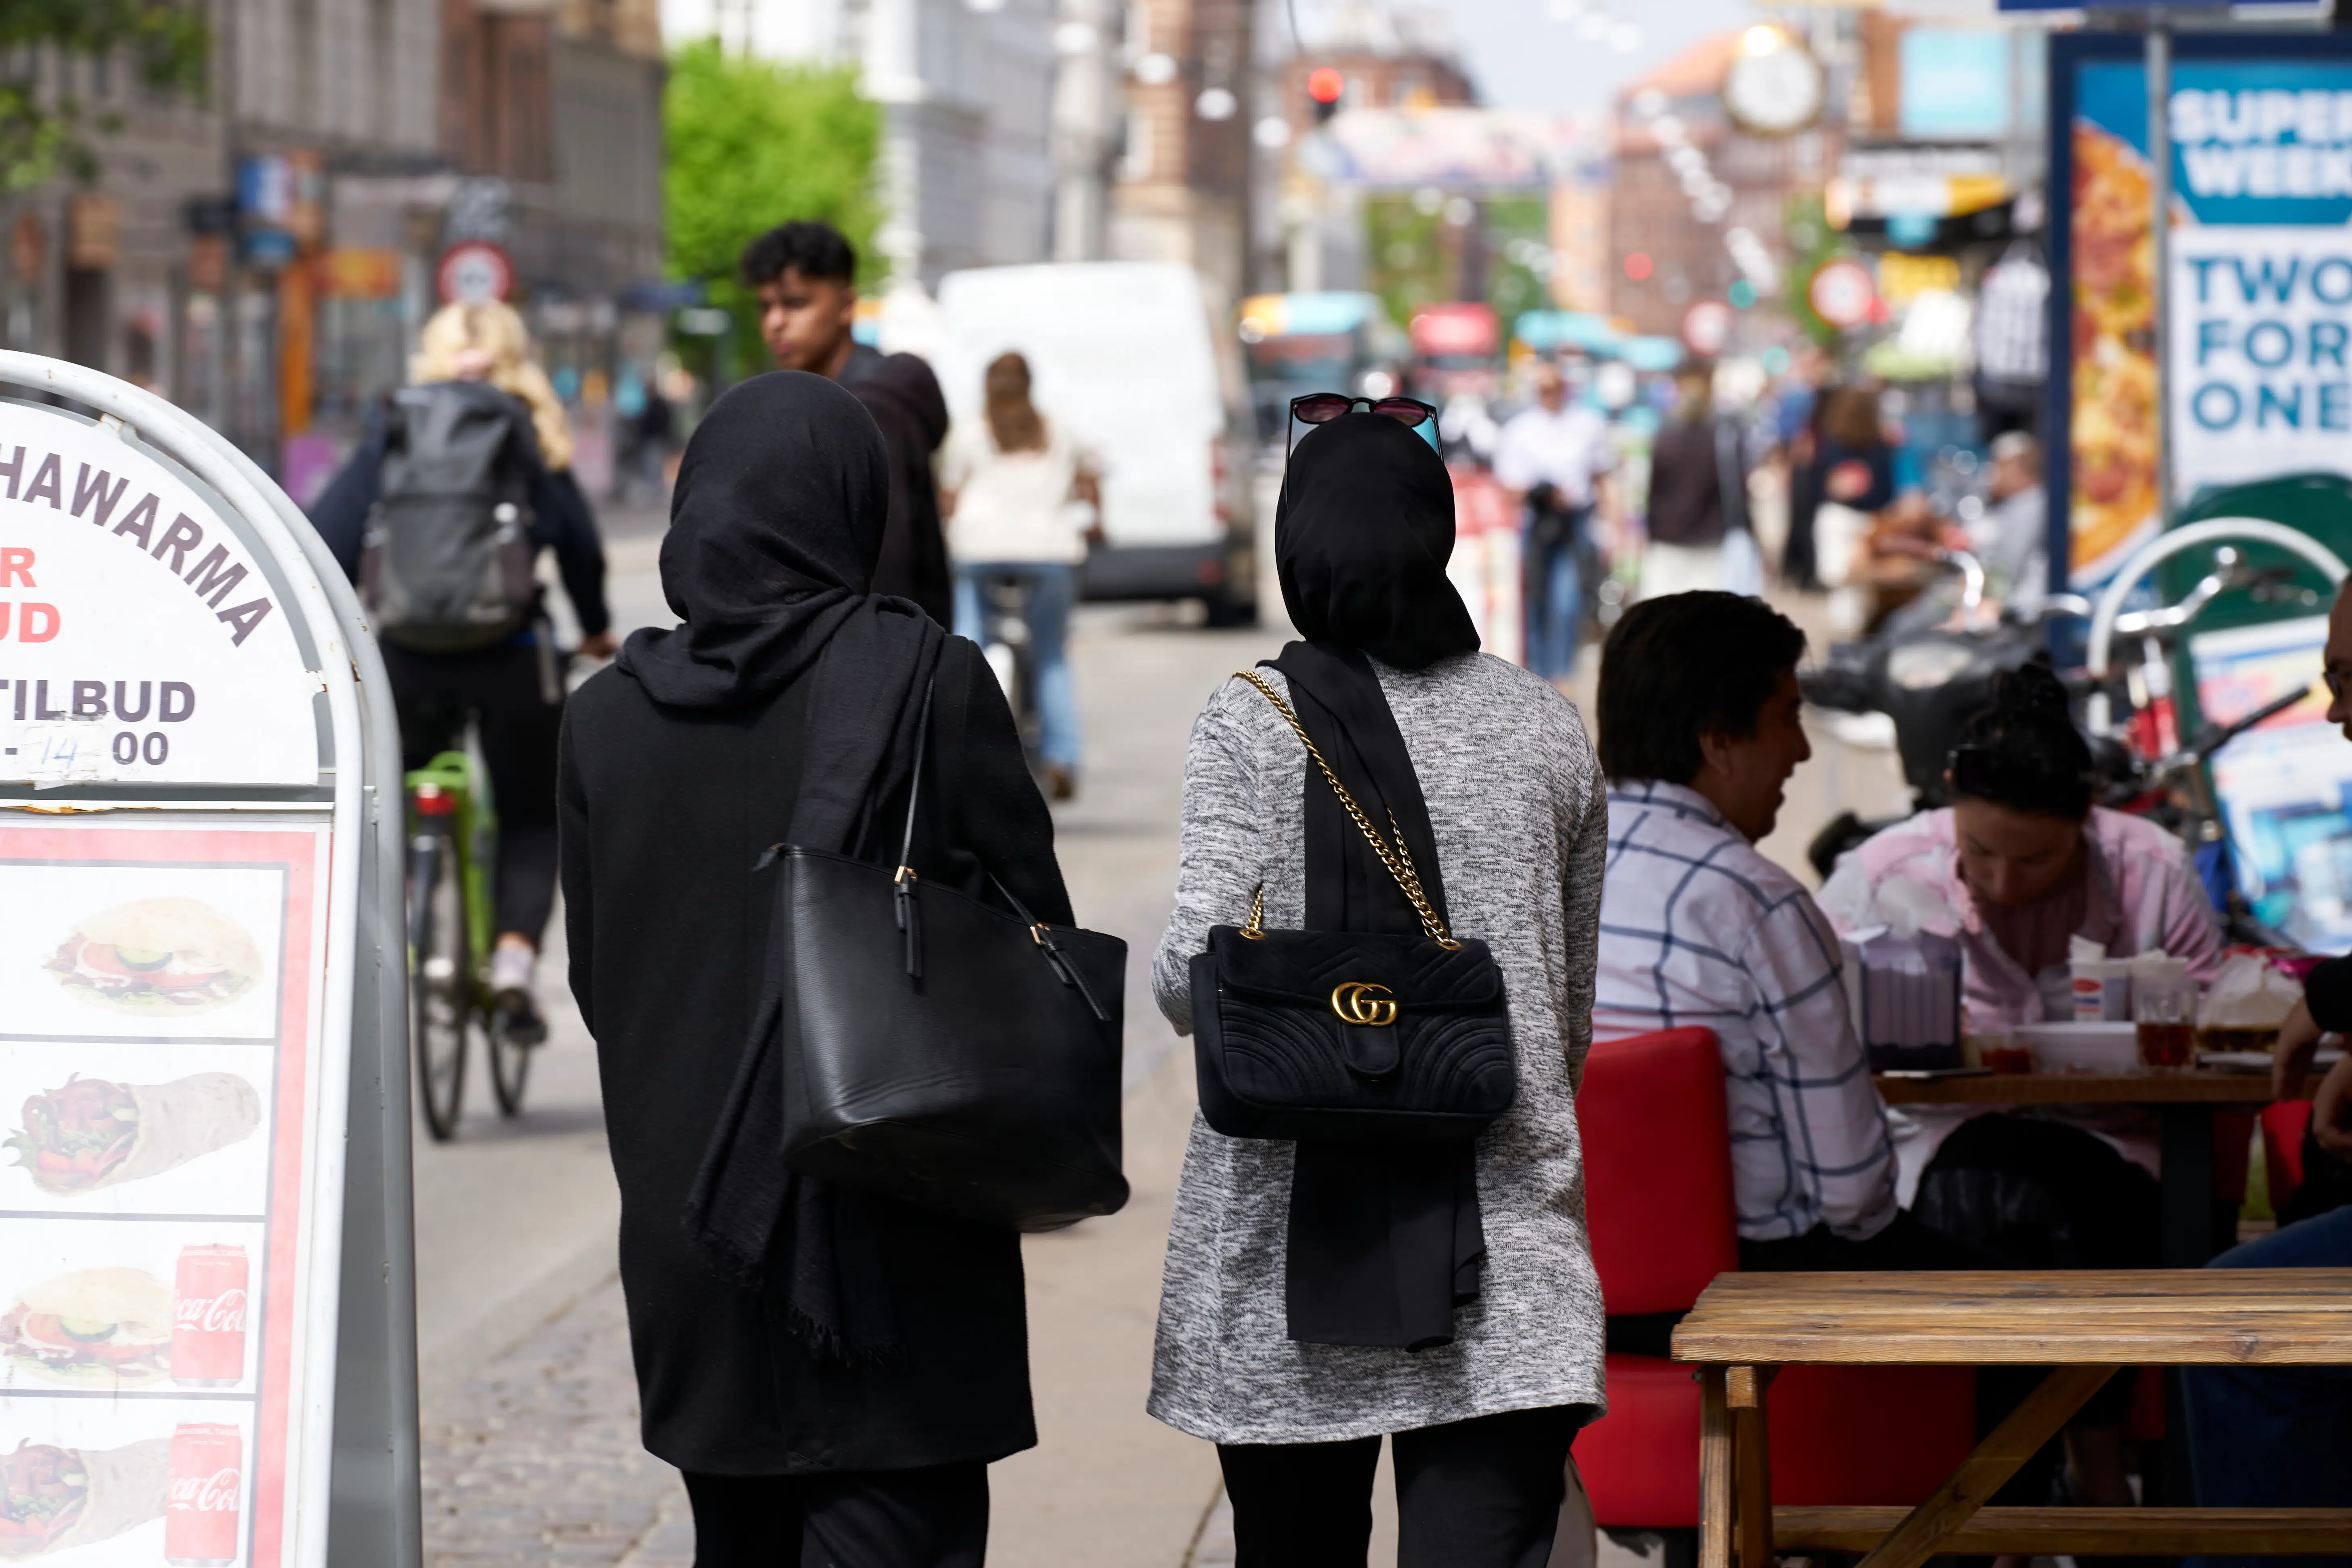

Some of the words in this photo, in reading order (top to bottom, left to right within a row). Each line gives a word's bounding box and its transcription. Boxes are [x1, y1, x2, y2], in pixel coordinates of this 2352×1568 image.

[2186, 255, 2352, 306] TWO
[2196, 318, 2350, 369] FOR
[2191, 381, 2352, 433] ONE
[40, 736, 78, 770] 14
[112, 731, 168, 765] 00
[1331, 981, 1398, 1027] GG
